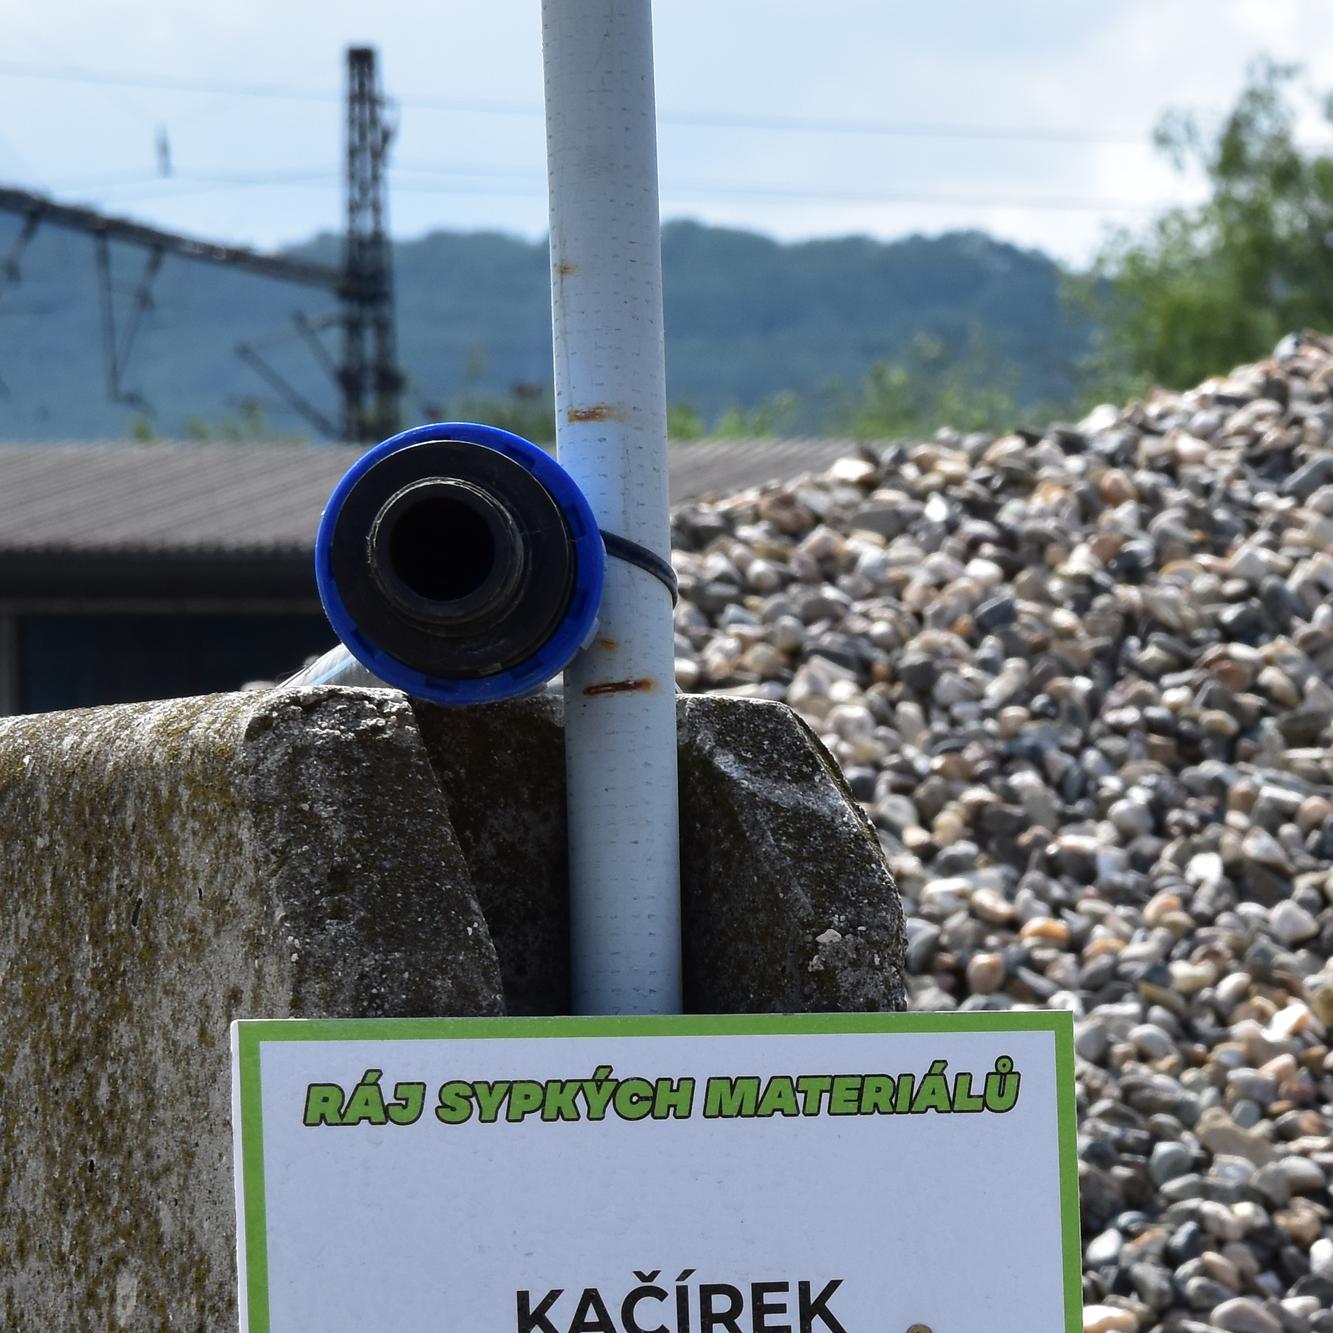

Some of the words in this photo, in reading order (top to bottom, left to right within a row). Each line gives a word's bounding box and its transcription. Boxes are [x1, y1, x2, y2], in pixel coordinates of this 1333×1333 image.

[303, 1069, 426, 1126] RÁJ
[435, 1065, 696, 1123] SYPKÝCH
[703, 1055, 1021, 1117] MATERIÁLŮ
